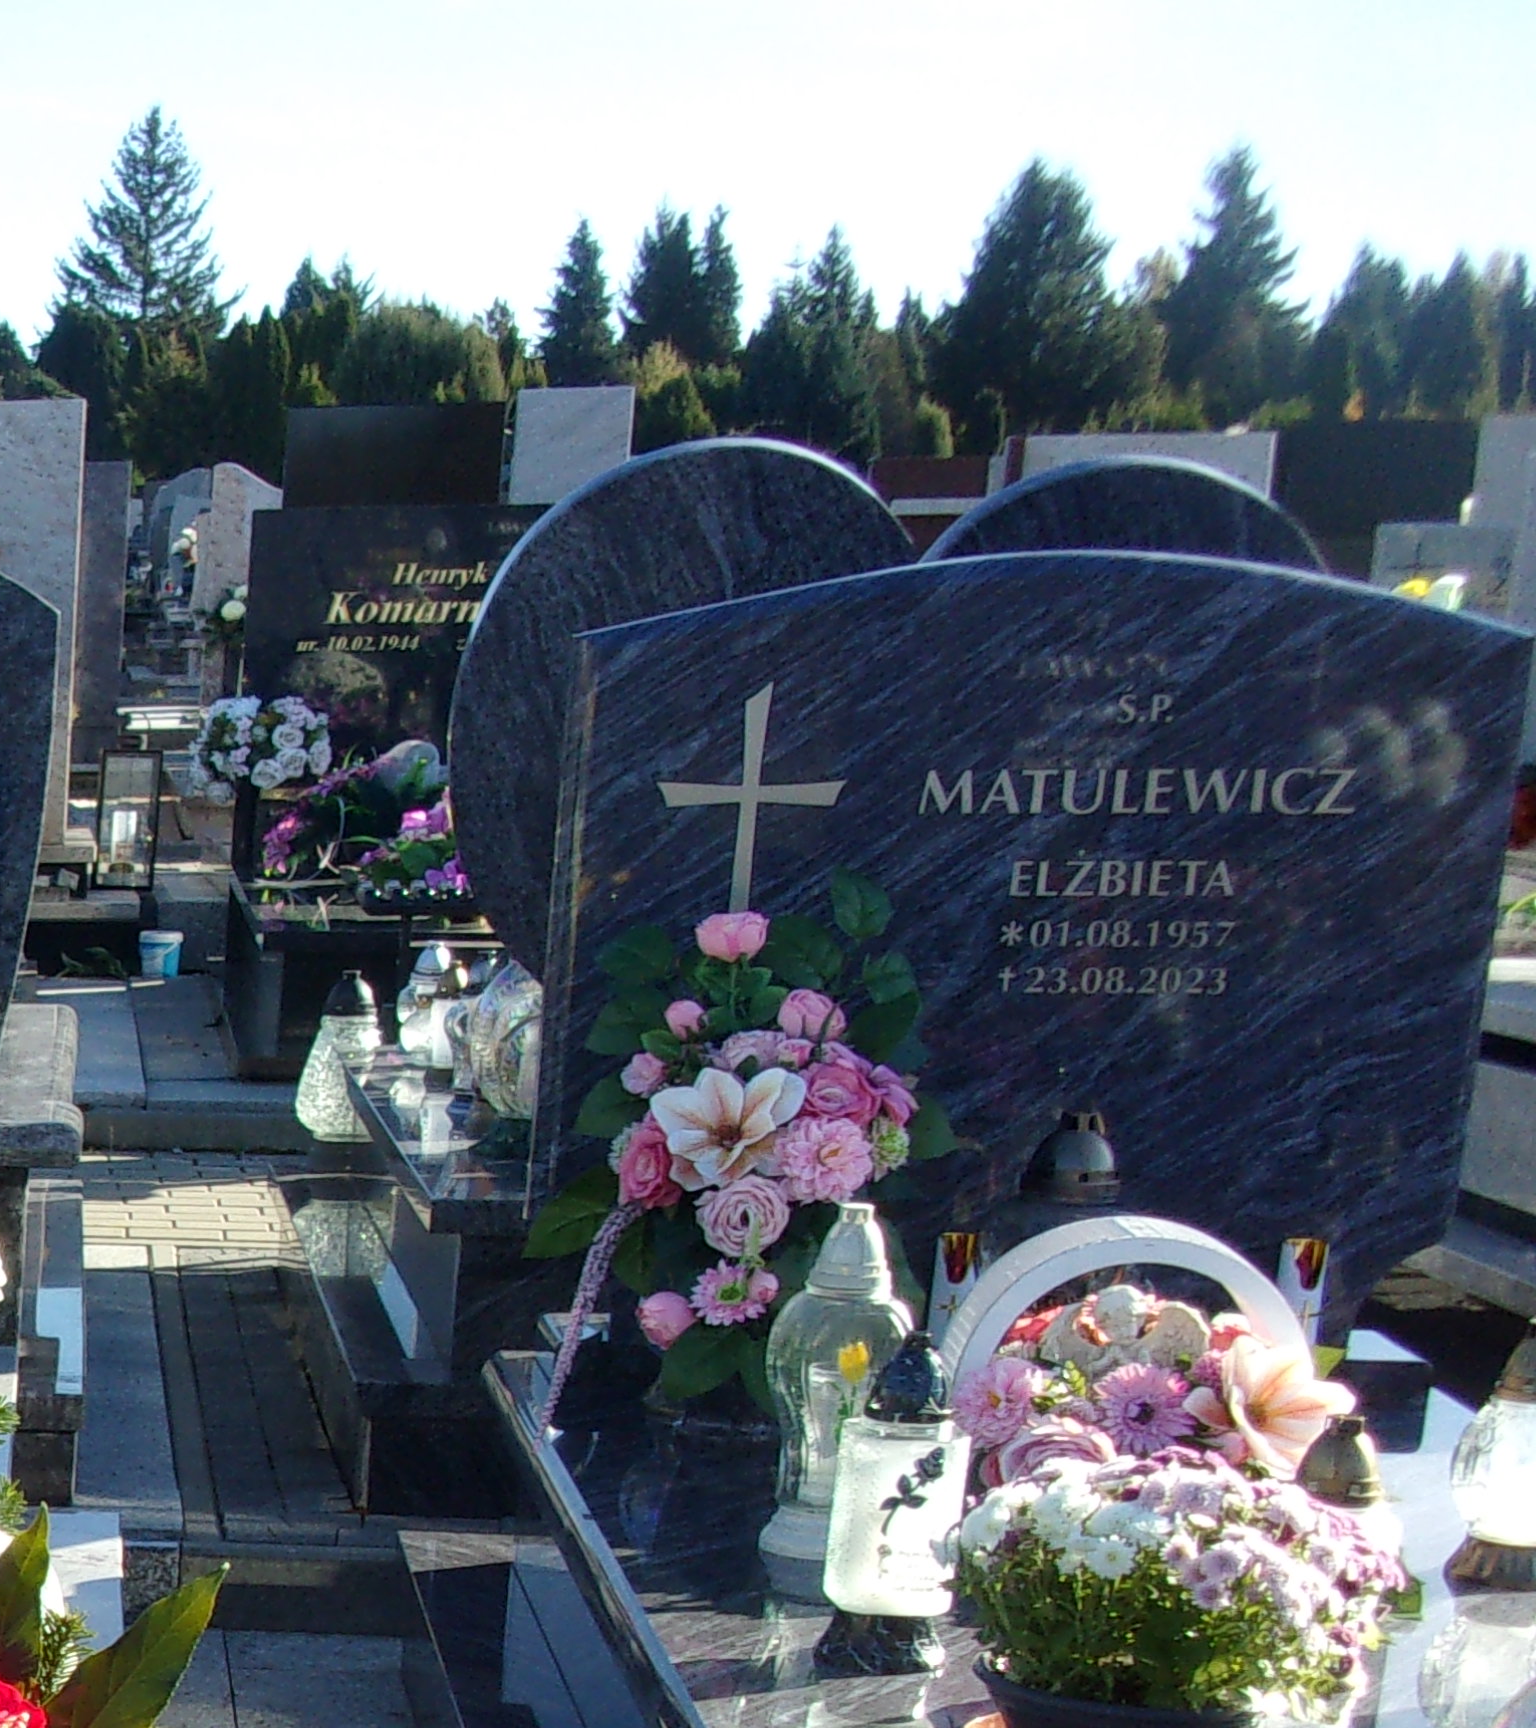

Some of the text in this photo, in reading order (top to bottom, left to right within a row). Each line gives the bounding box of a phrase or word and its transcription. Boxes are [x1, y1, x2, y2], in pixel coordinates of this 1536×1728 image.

[392, 561, 489, 591] Henryk
[324, 591, 481, 625] Komarn
[917, 767, 1357, 816] MATULEWICZ
[1009, 849, 1236, 898] ELŻBIETA
[1023, 967, 1228, 995] 23.08.2023
